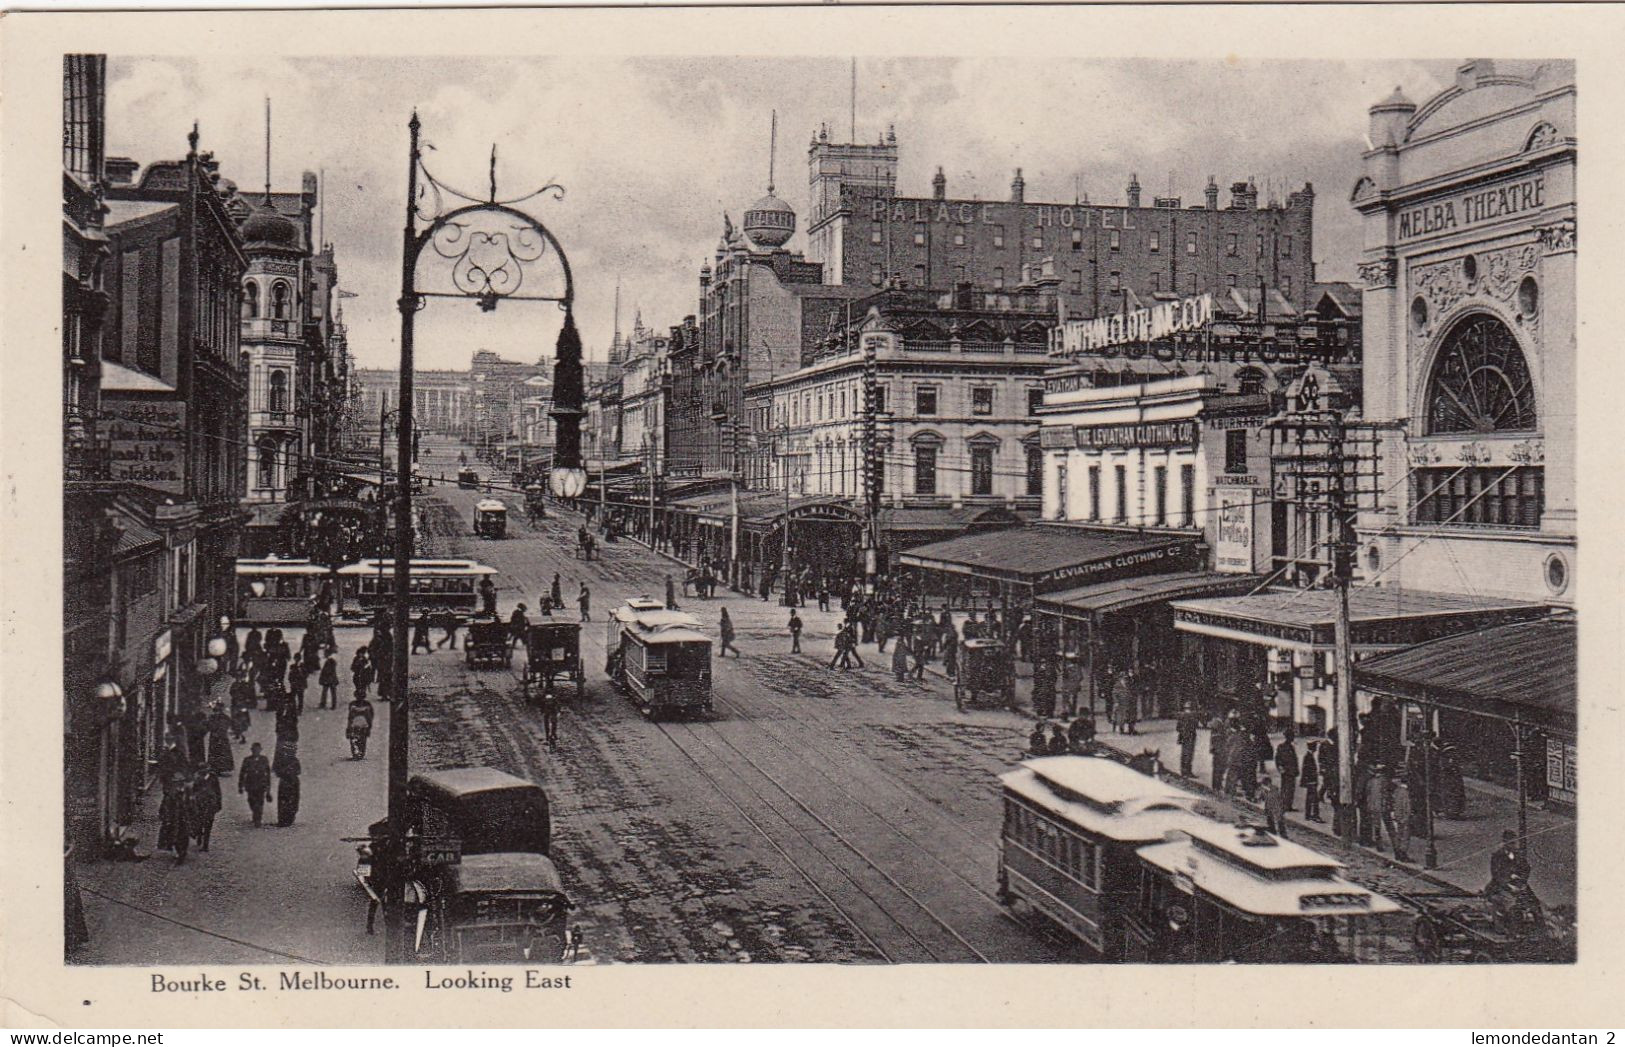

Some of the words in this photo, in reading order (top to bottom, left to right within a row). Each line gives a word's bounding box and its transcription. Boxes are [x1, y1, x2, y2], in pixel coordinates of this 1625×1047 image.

[871, 200, 997, 225] PALACE
[1038, 205, 1136, 231] HOTEL
[1399, 201, 1457, 240] MELBA
[1463, 178, 1545, 224] THEATRE
[1092, 426, 1136, 446] LEVIATHAN
[1136, 423, 1177, 444] CLOTHING
[1053, 560, 1112, 580] LEVIATHAN
[1115, 549, 1164, 567] CLOTHING
